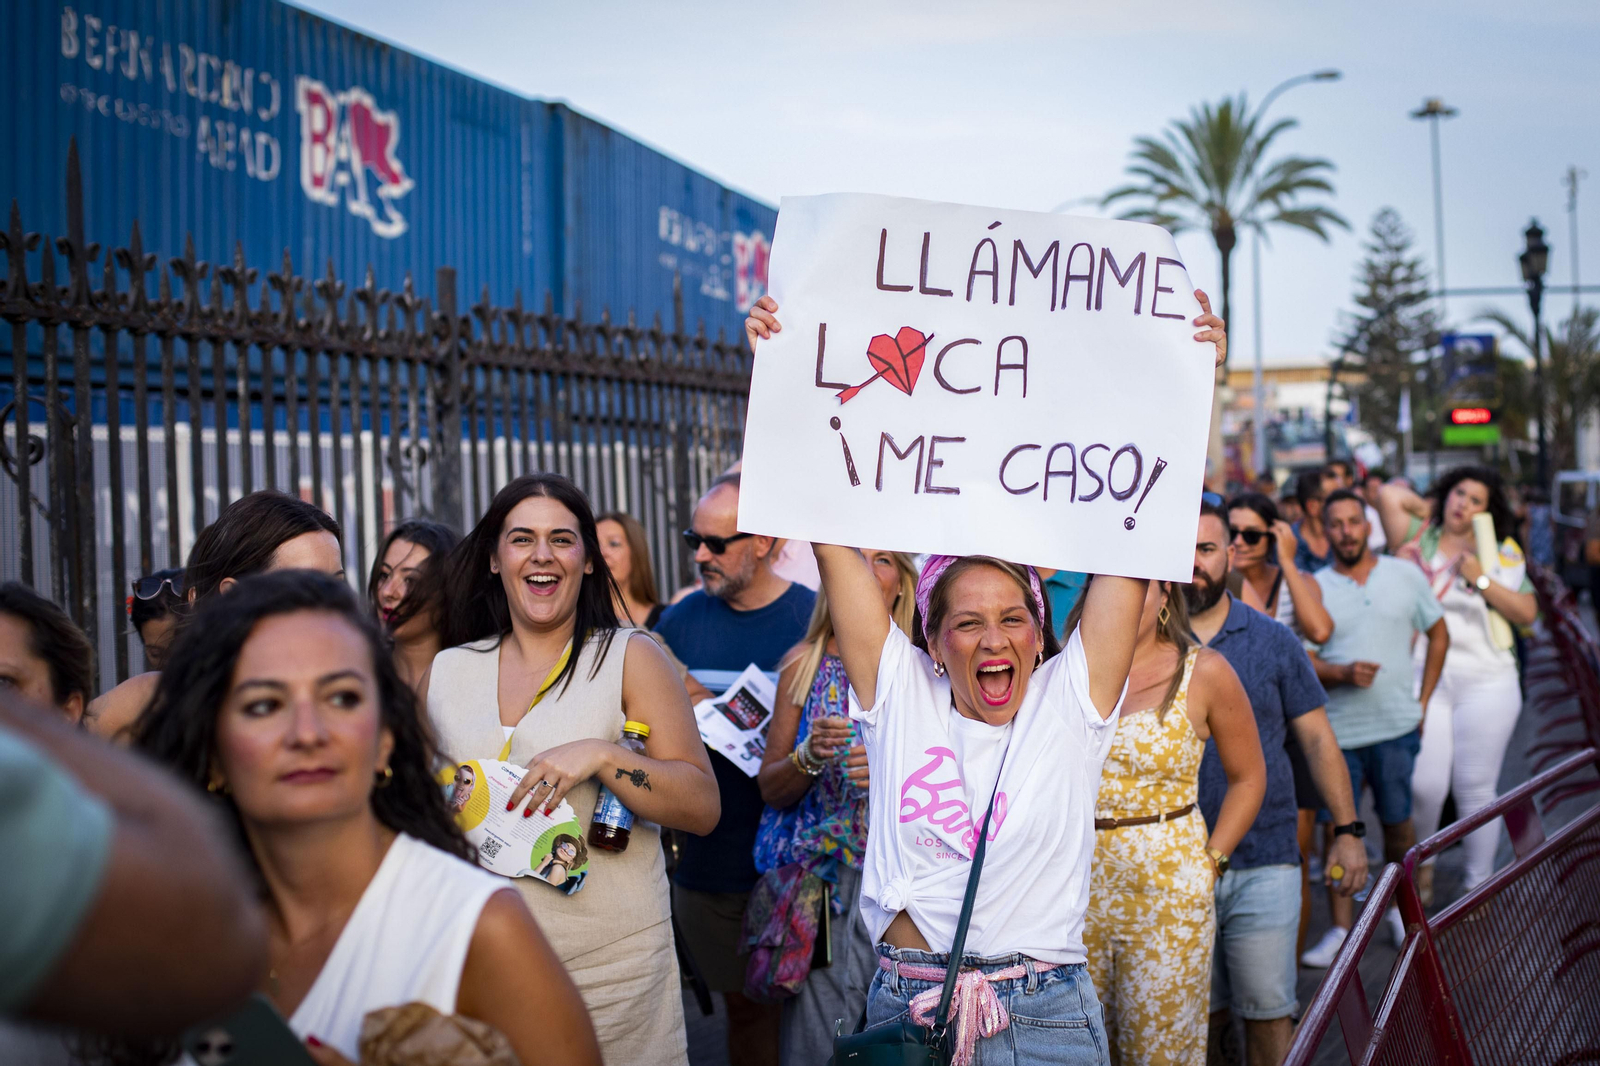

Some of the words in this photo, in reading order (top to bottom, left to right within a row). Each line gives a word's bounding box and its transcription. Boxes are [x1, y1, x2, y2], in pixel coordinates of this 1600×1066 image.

[876, 221, 1188, 320] LLÁMAME
[999, 442, 1168, 530] CASO!
[916, 836, 942, 848] LOS
[936, 852, 963, 861] SINCE
